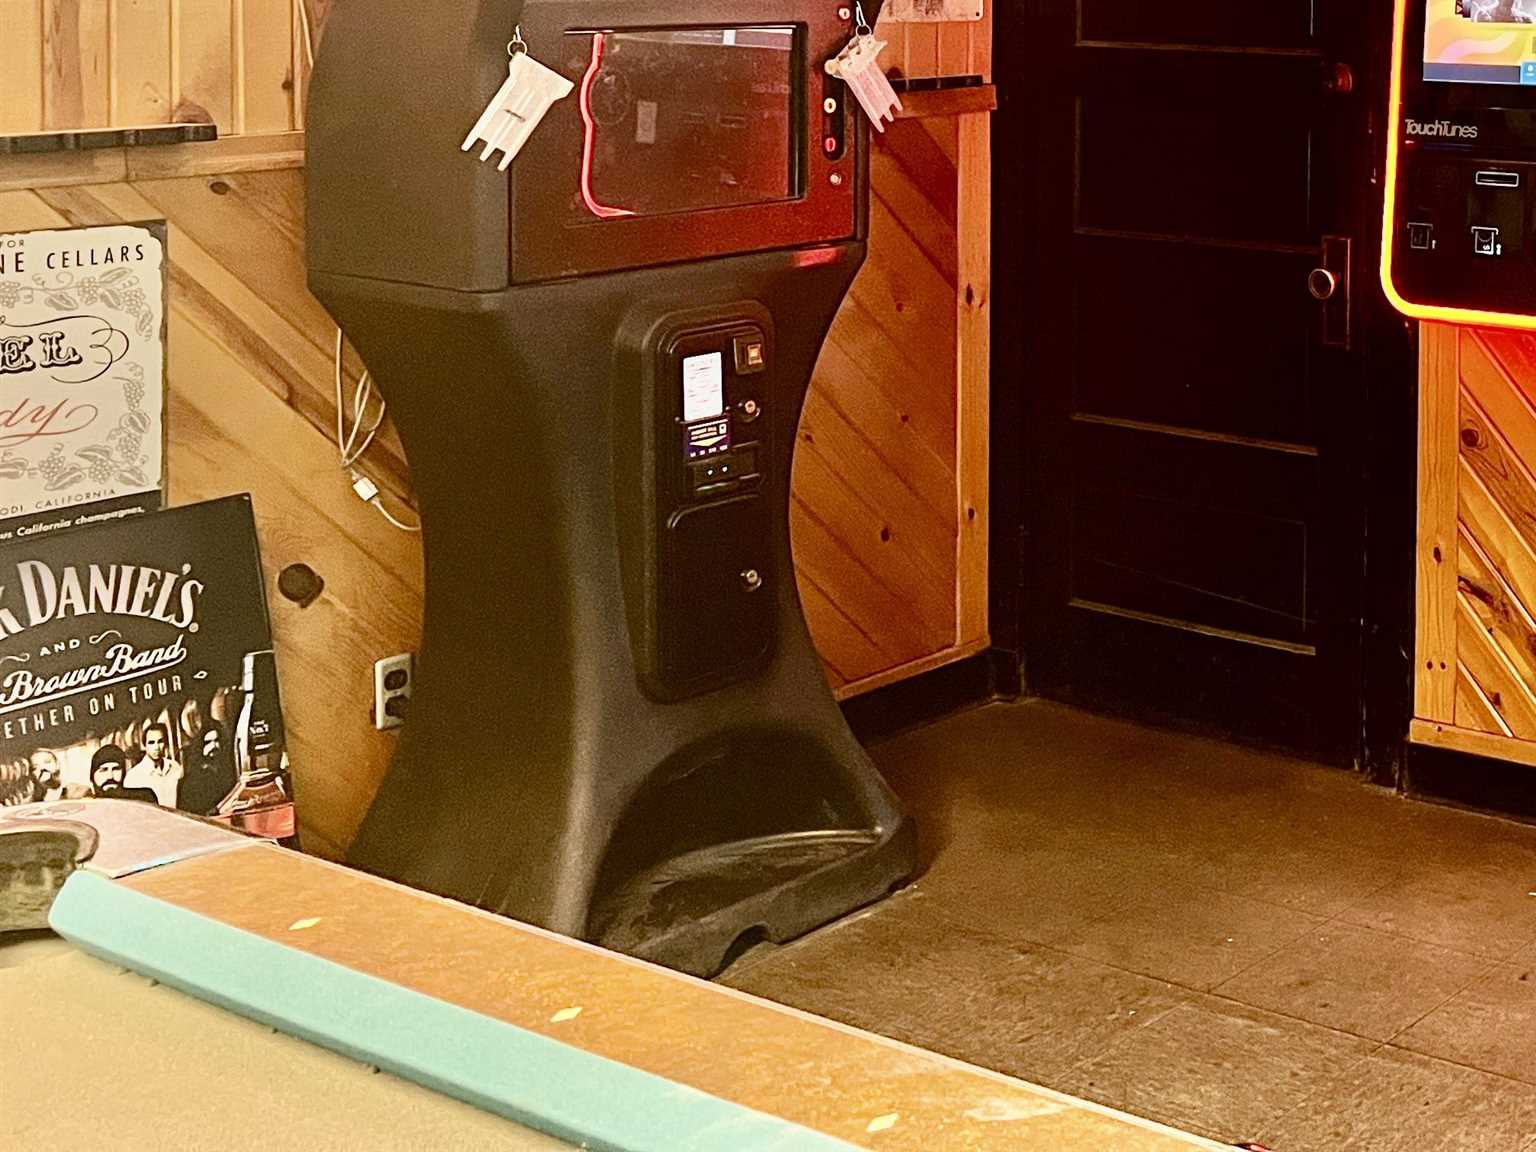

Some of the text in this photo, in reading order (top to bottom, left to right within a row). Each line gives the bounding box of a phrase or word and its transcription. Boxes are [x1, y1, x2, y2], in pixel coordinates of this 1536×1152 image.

[1405, 119, 1478, 138] TouchTunes
[47, 244, 144, 269] CELLARS
[35, 489, 116, 510] CALIFORNIA
[17, 519, 71, 536] California
[17, 560, 204, 629] DANIEL'S
[40, 638, 80, 656] AND
[97, 634, 187, 677] Band
[89, 693, 115, 715] ON
[129, 676, 182, 704] TOUR
